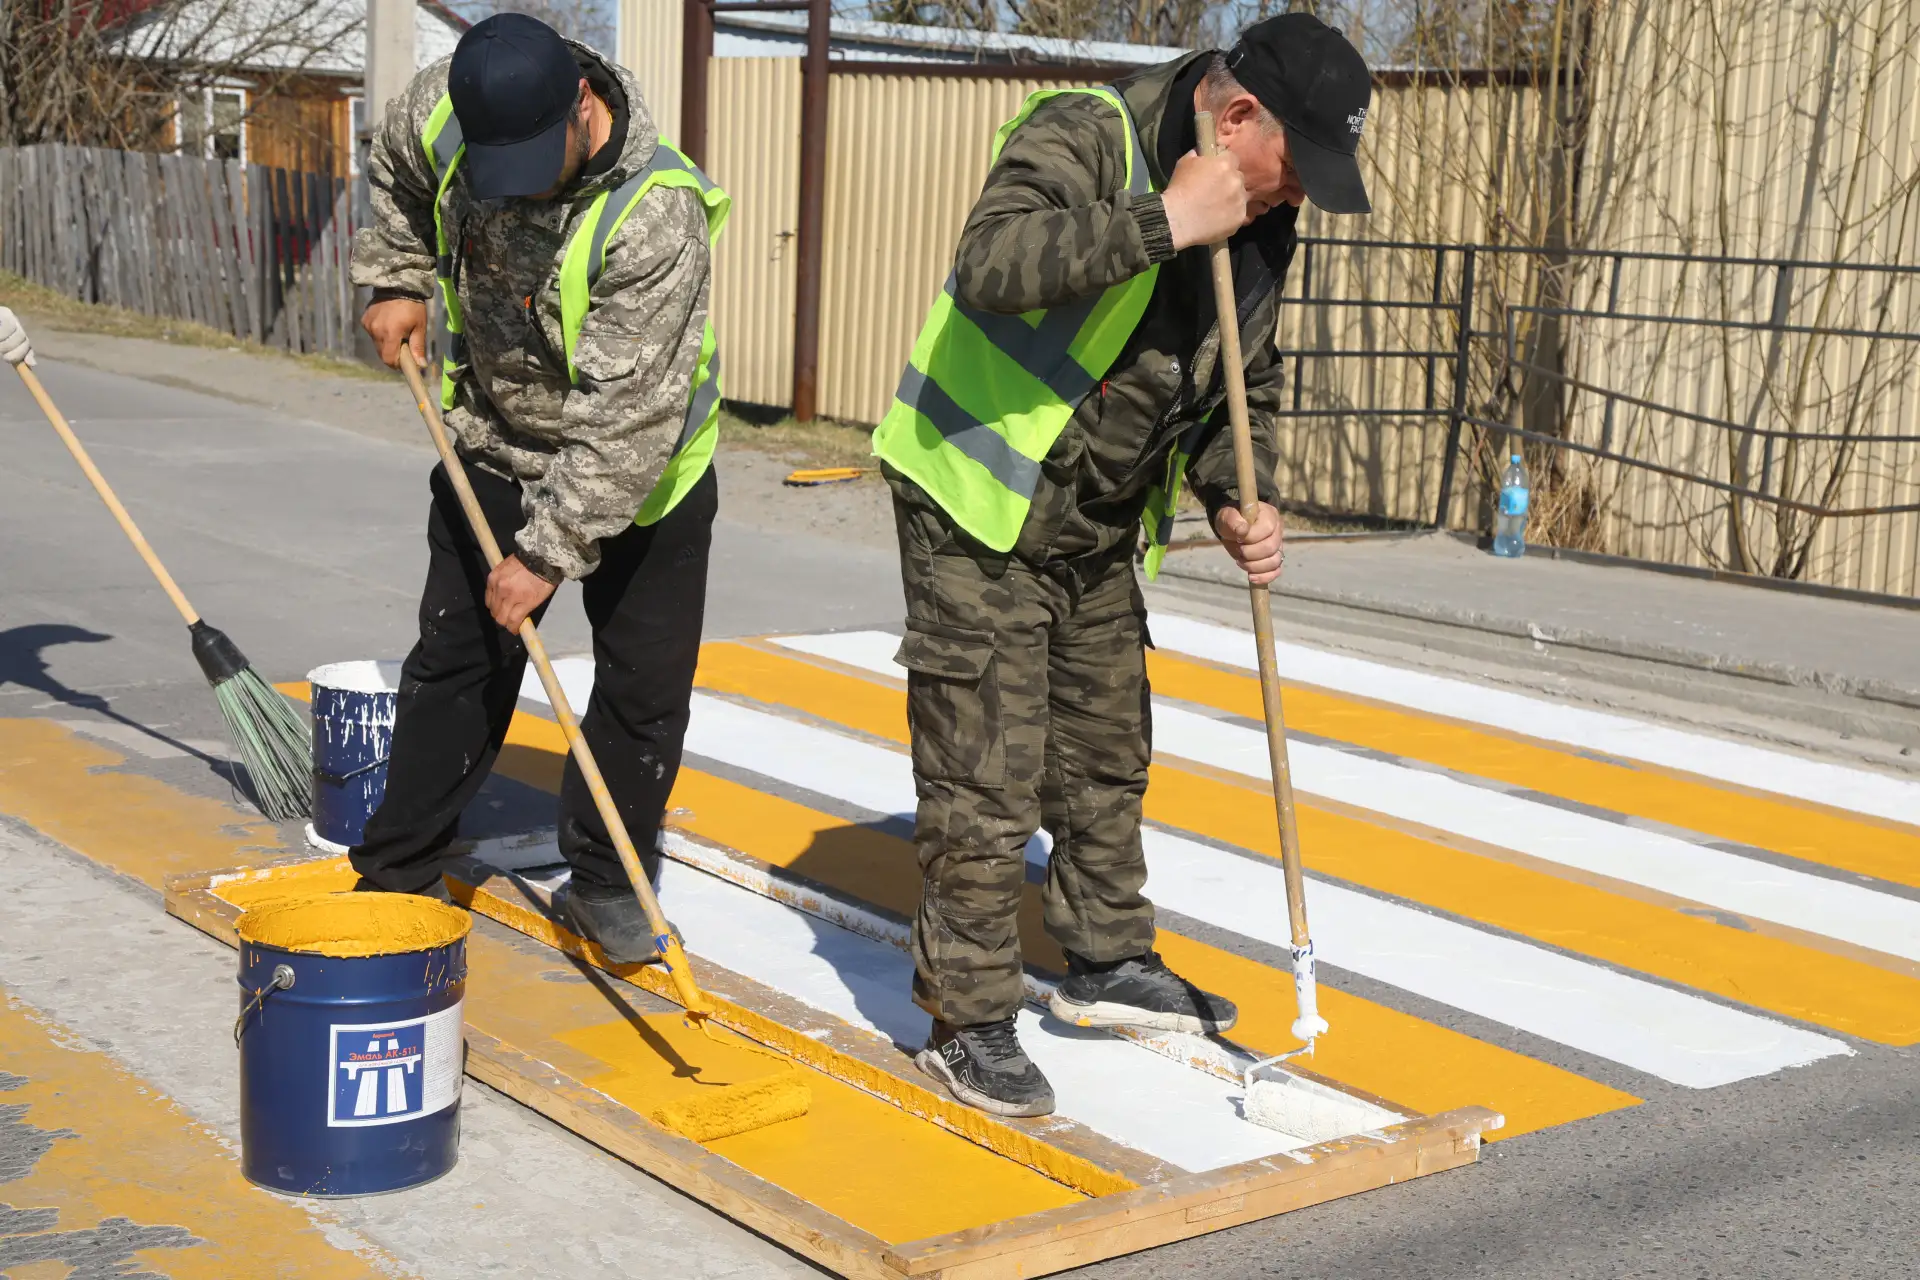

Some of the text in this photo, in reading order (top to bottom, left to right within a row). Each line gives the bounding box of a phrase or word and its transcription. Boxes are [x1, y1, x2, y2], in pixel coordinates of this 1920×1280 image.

[1346, 114, 1364, 126] NORT
[1349, 125, 1362, 134] FAC
[348, 1045, 417, 1061] Эмаль АК-511
